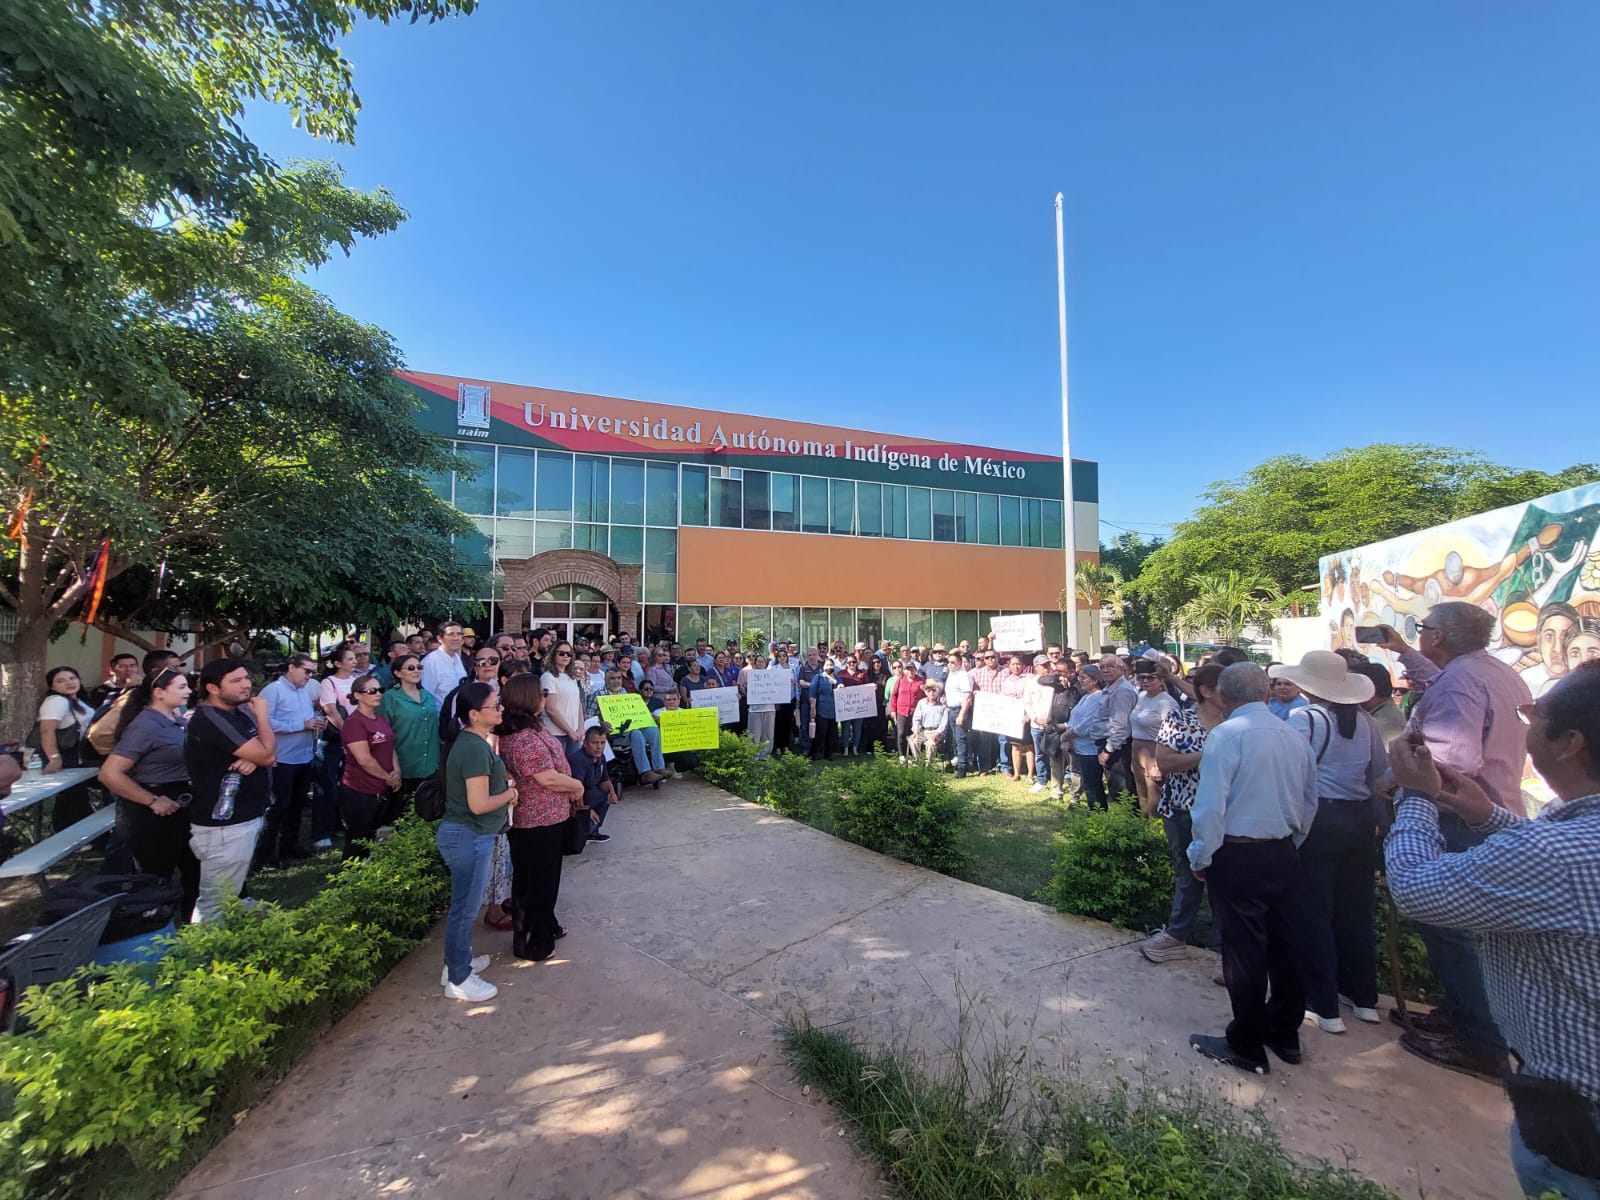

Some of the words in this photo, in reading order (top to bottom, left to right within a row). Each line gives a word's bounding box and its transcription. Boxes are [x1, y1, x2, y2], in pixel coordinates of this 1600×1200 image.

[457, 428, 489, 438] uaim
[523, 402, 701, 443] Universidad
[709, 425, 836, 458] Autónoma
[844, 440, 931, 470] Indígena
[938, 452, 959, 472] de
[963, 455, 1026, 480] México
